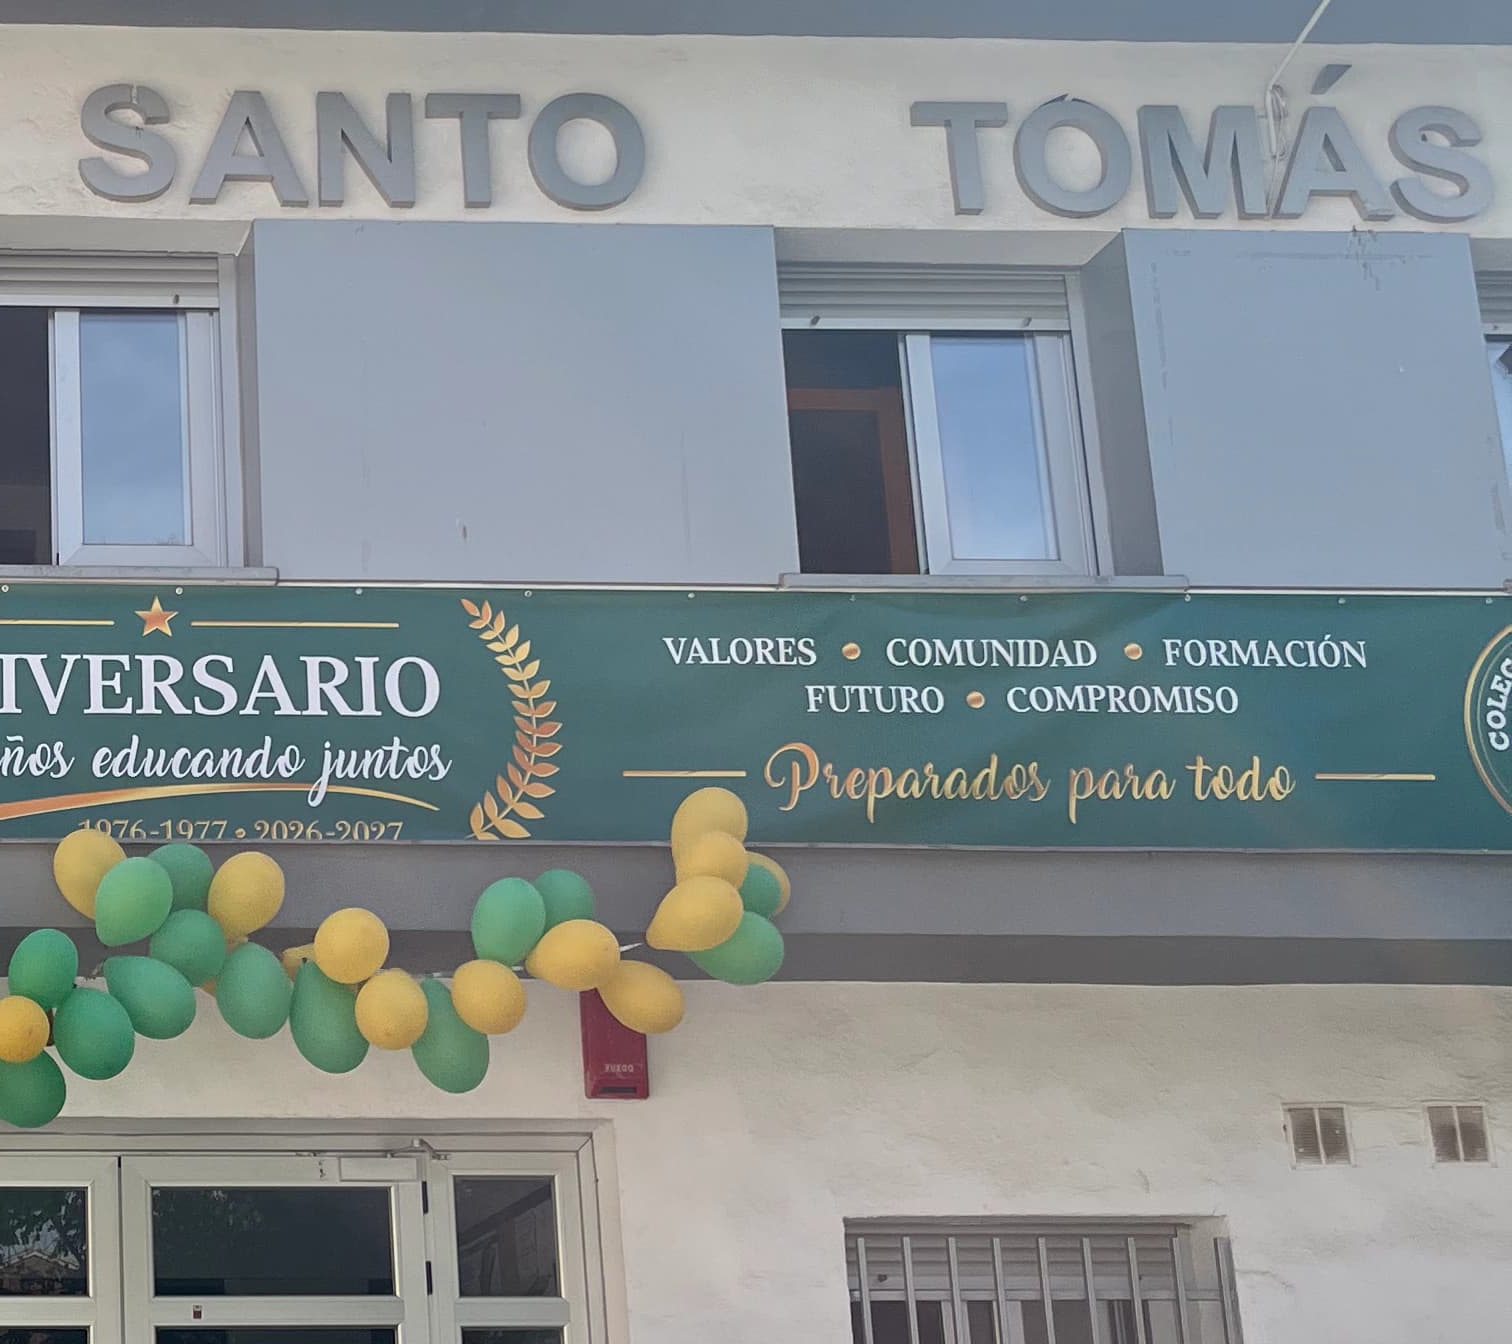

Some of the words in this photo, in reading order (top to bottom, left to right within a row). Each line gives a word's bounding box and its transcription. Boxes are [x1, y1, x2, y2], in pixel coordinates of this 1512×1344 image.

[78, 84, 647, 211] SANTO
[910, 64, 1495, 223] TOMÁS
[662, 636, 818, 668] VALORES
[885, 637, 1098, 670] COMUNIDAD
[1162, 634, 1369, 670] FORMACIÓN
[805, 684, 946, 715] FUTURO
[1006, 684, 1240, 716] COMPROMISO
[91, 735, 306, 782] educando
[306, 737, 453, 808] juntos
[763, 741, 1051, 825] Preparados
[1068, 766, 1178, 826] para
[1184, 752, 1298, 803] todo
[254, 820, 404, 841] 2026-2027
